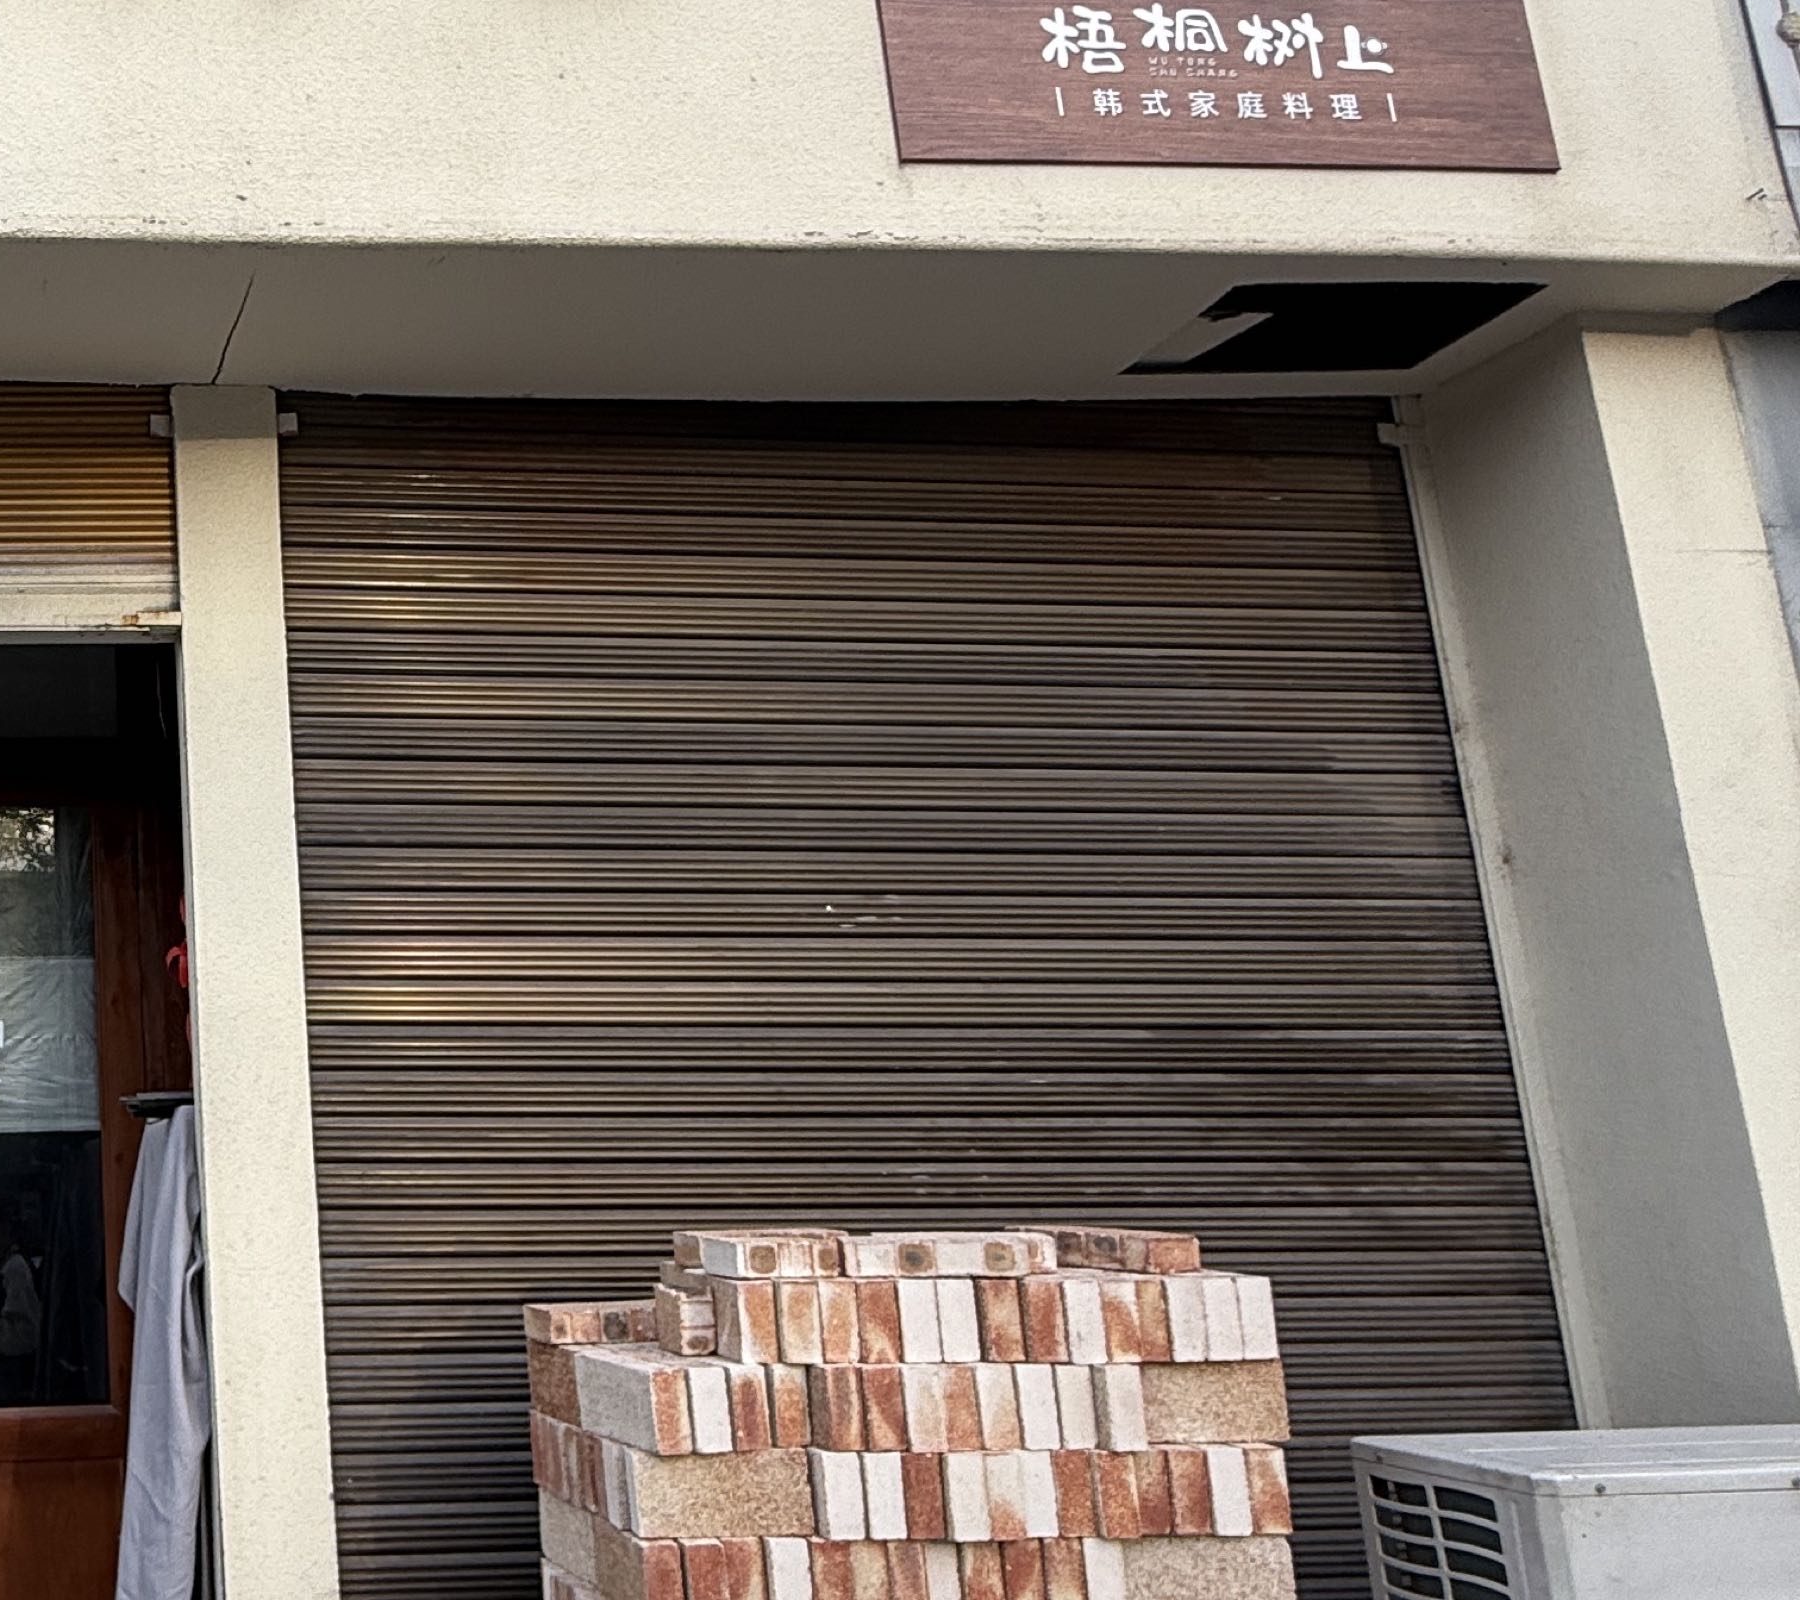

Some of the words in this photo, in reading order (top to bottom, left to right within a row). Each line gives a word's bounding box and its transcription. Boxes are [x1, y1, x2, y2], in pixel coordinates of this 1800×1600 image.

[1040, 2, 1395, 78] 梧桐树上
[1093, 88, 1363, 121] 韩式家庭料理
